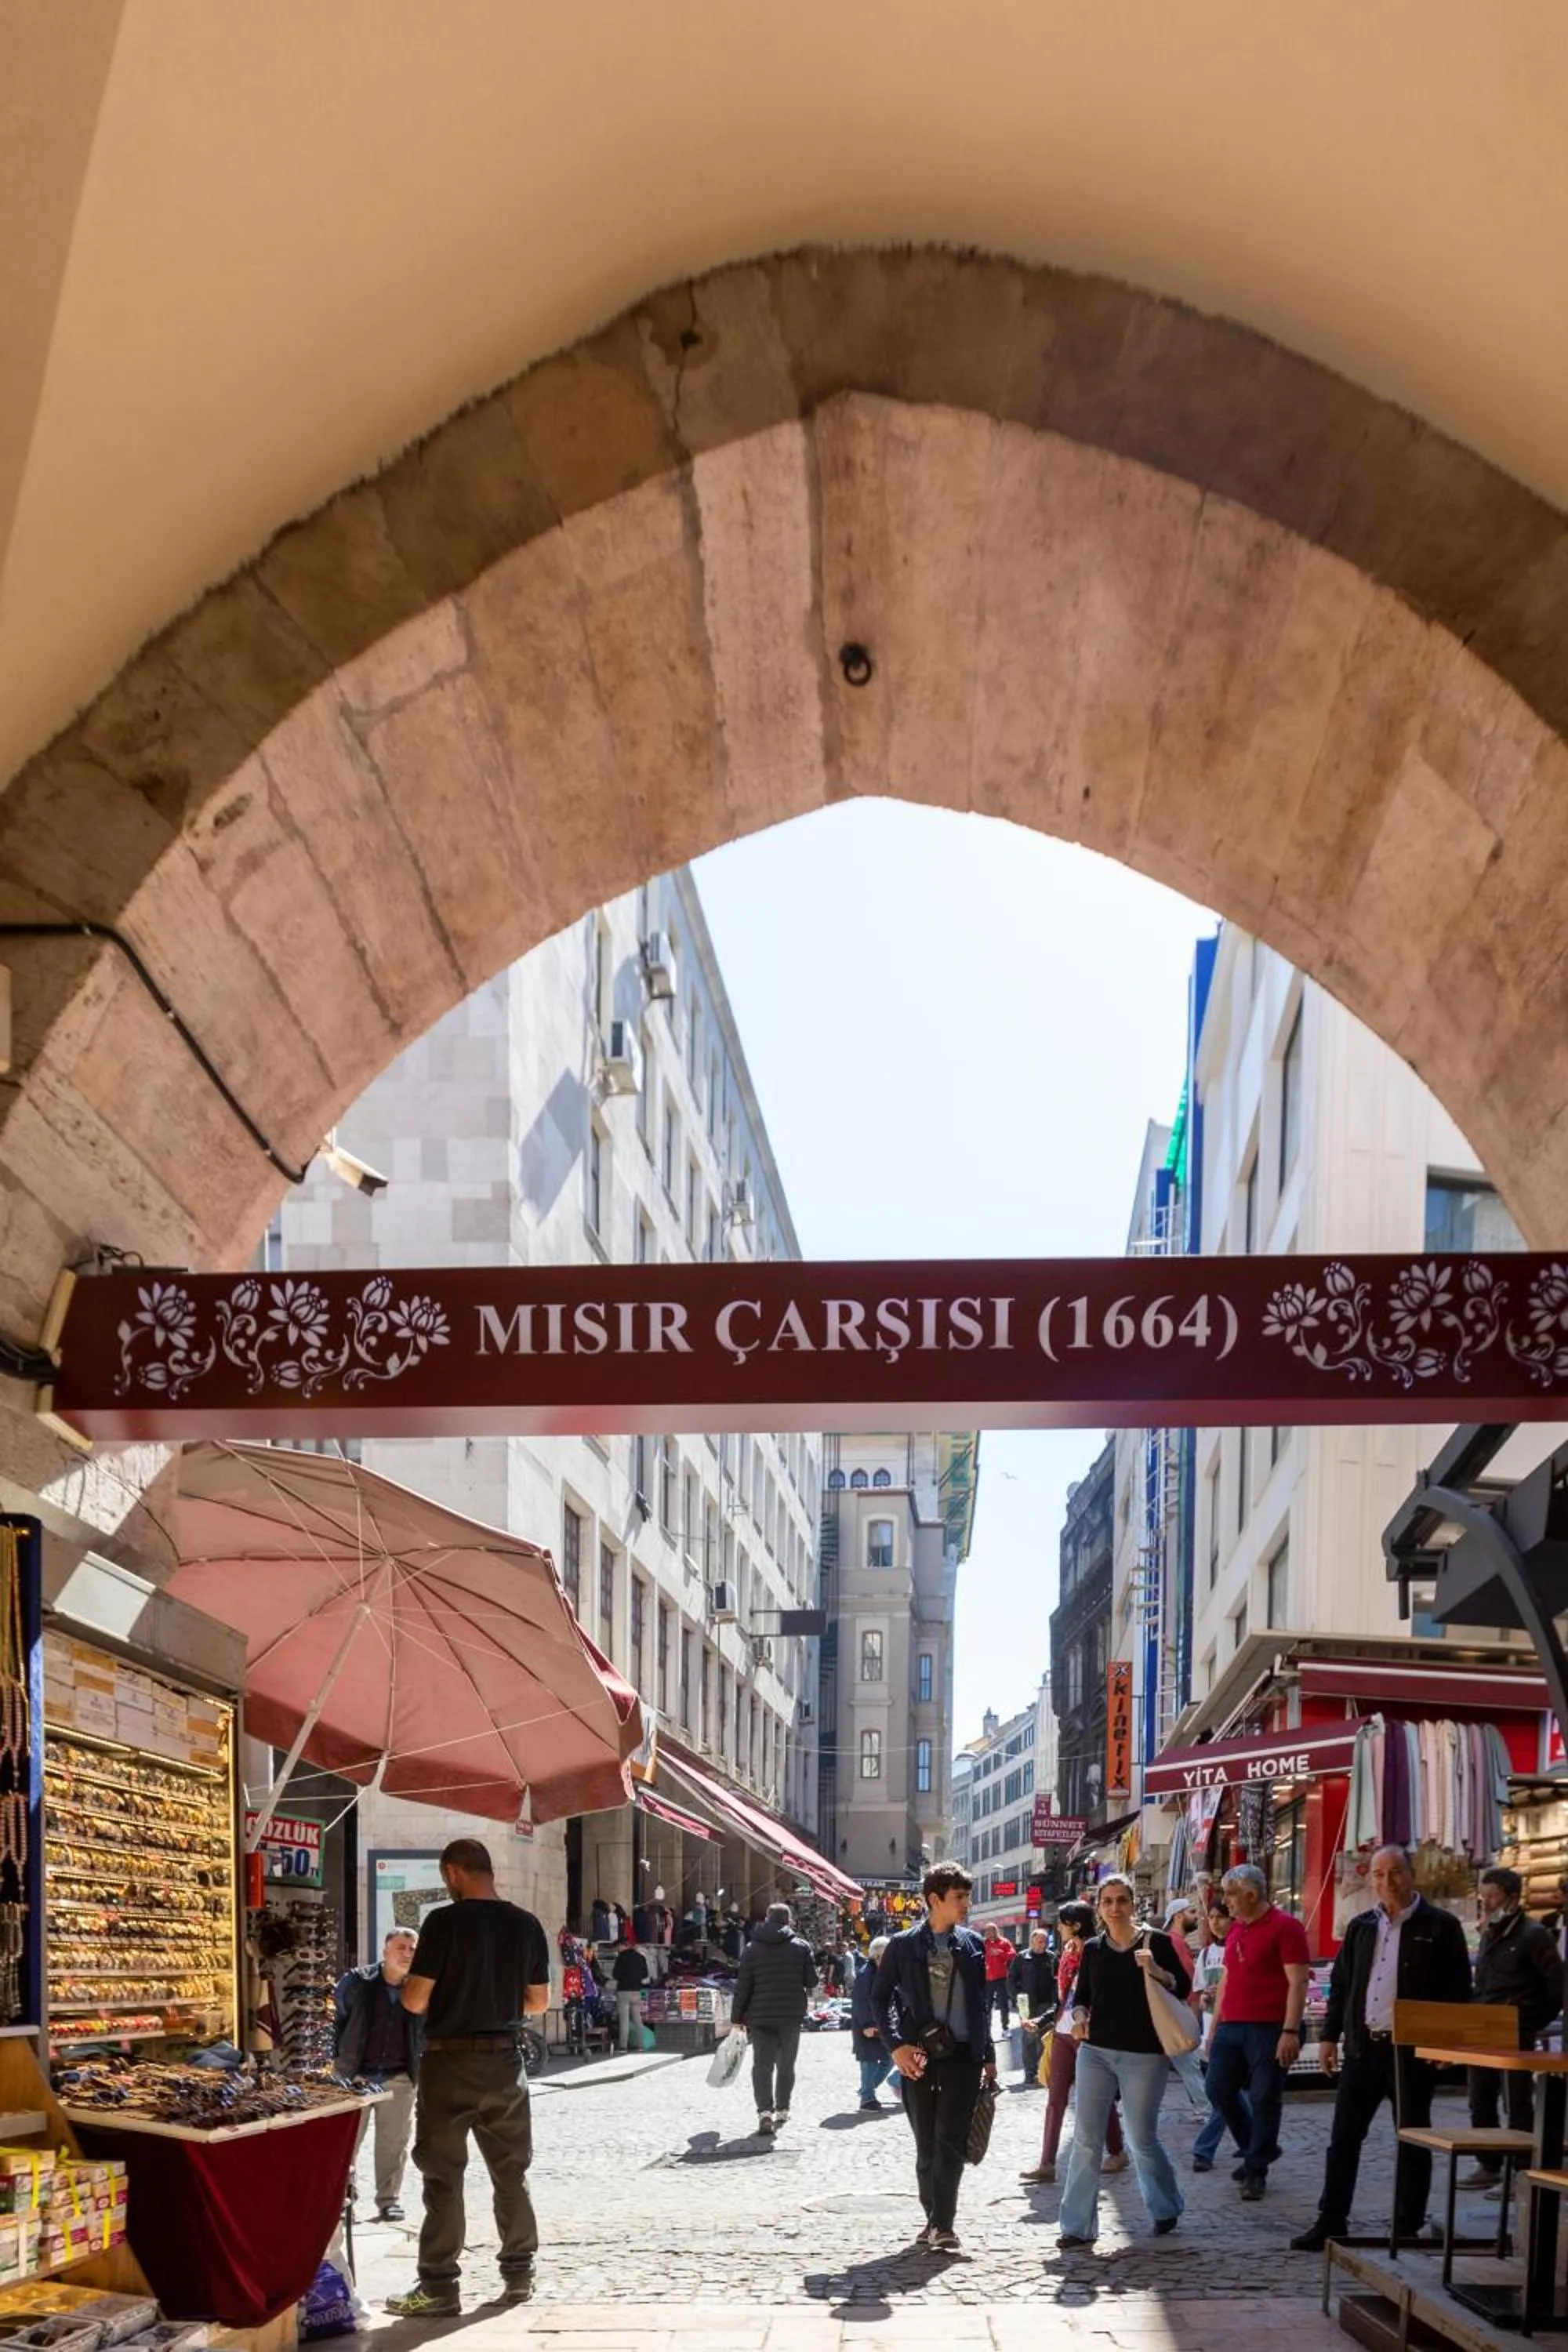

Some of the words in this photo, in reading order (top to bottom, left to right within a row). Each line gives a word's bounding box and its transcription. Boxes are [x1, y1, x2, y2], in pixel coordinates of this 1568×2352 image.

[474, 1301, 694, 1356] MISIR
[715, 1298, 1016, 1364] ÇARŞISI
[1038, 1294, 1239, 1363] (1664)
[1182, 1766, 1229, 1788] YİTA
[1247, 1754, 1311, 1779] HOME
